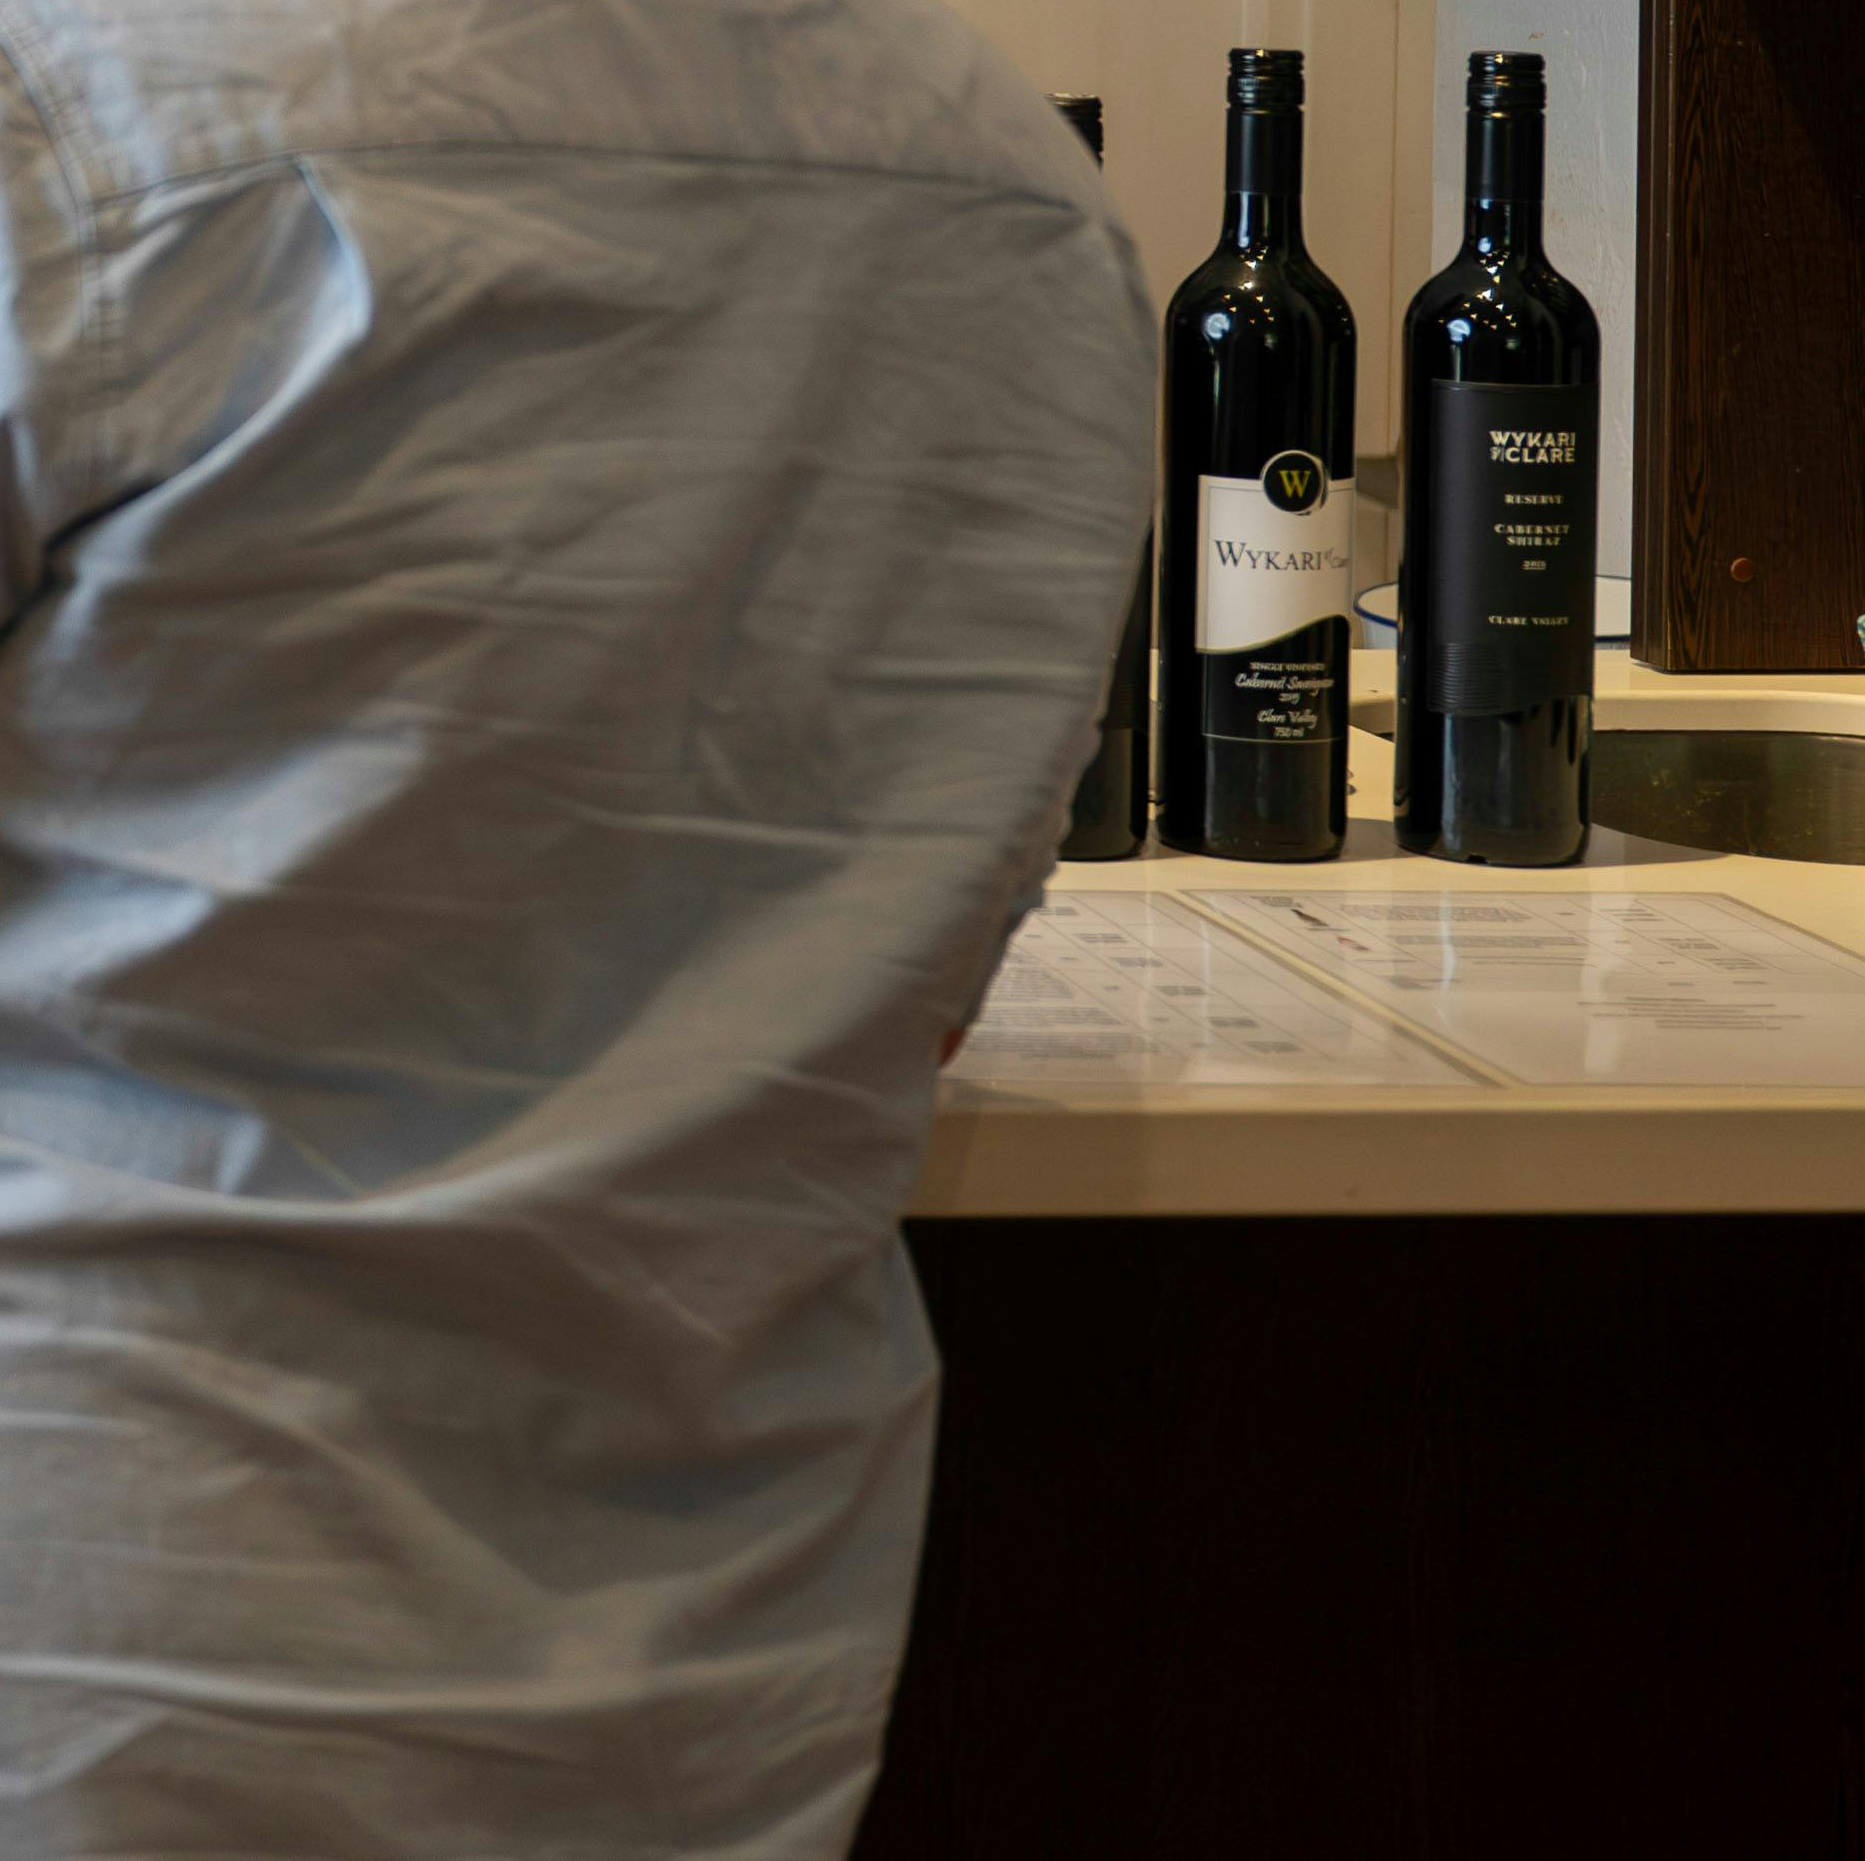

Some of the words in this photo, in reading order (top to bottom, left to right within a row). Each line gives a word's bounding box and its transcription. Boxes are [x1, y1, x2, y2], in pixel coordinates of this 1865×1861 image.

[1488, 430, 1576, 447] WYKARI
[1505, 446, 1576, 464] CLARE
[1280, 469, 1311, 500] W
[1503, 493, 1565, 506] RESERVE
[1493, 523, 1570, 535] CABERNET
[1506, 536, 1561, 547] SHIRAZ
